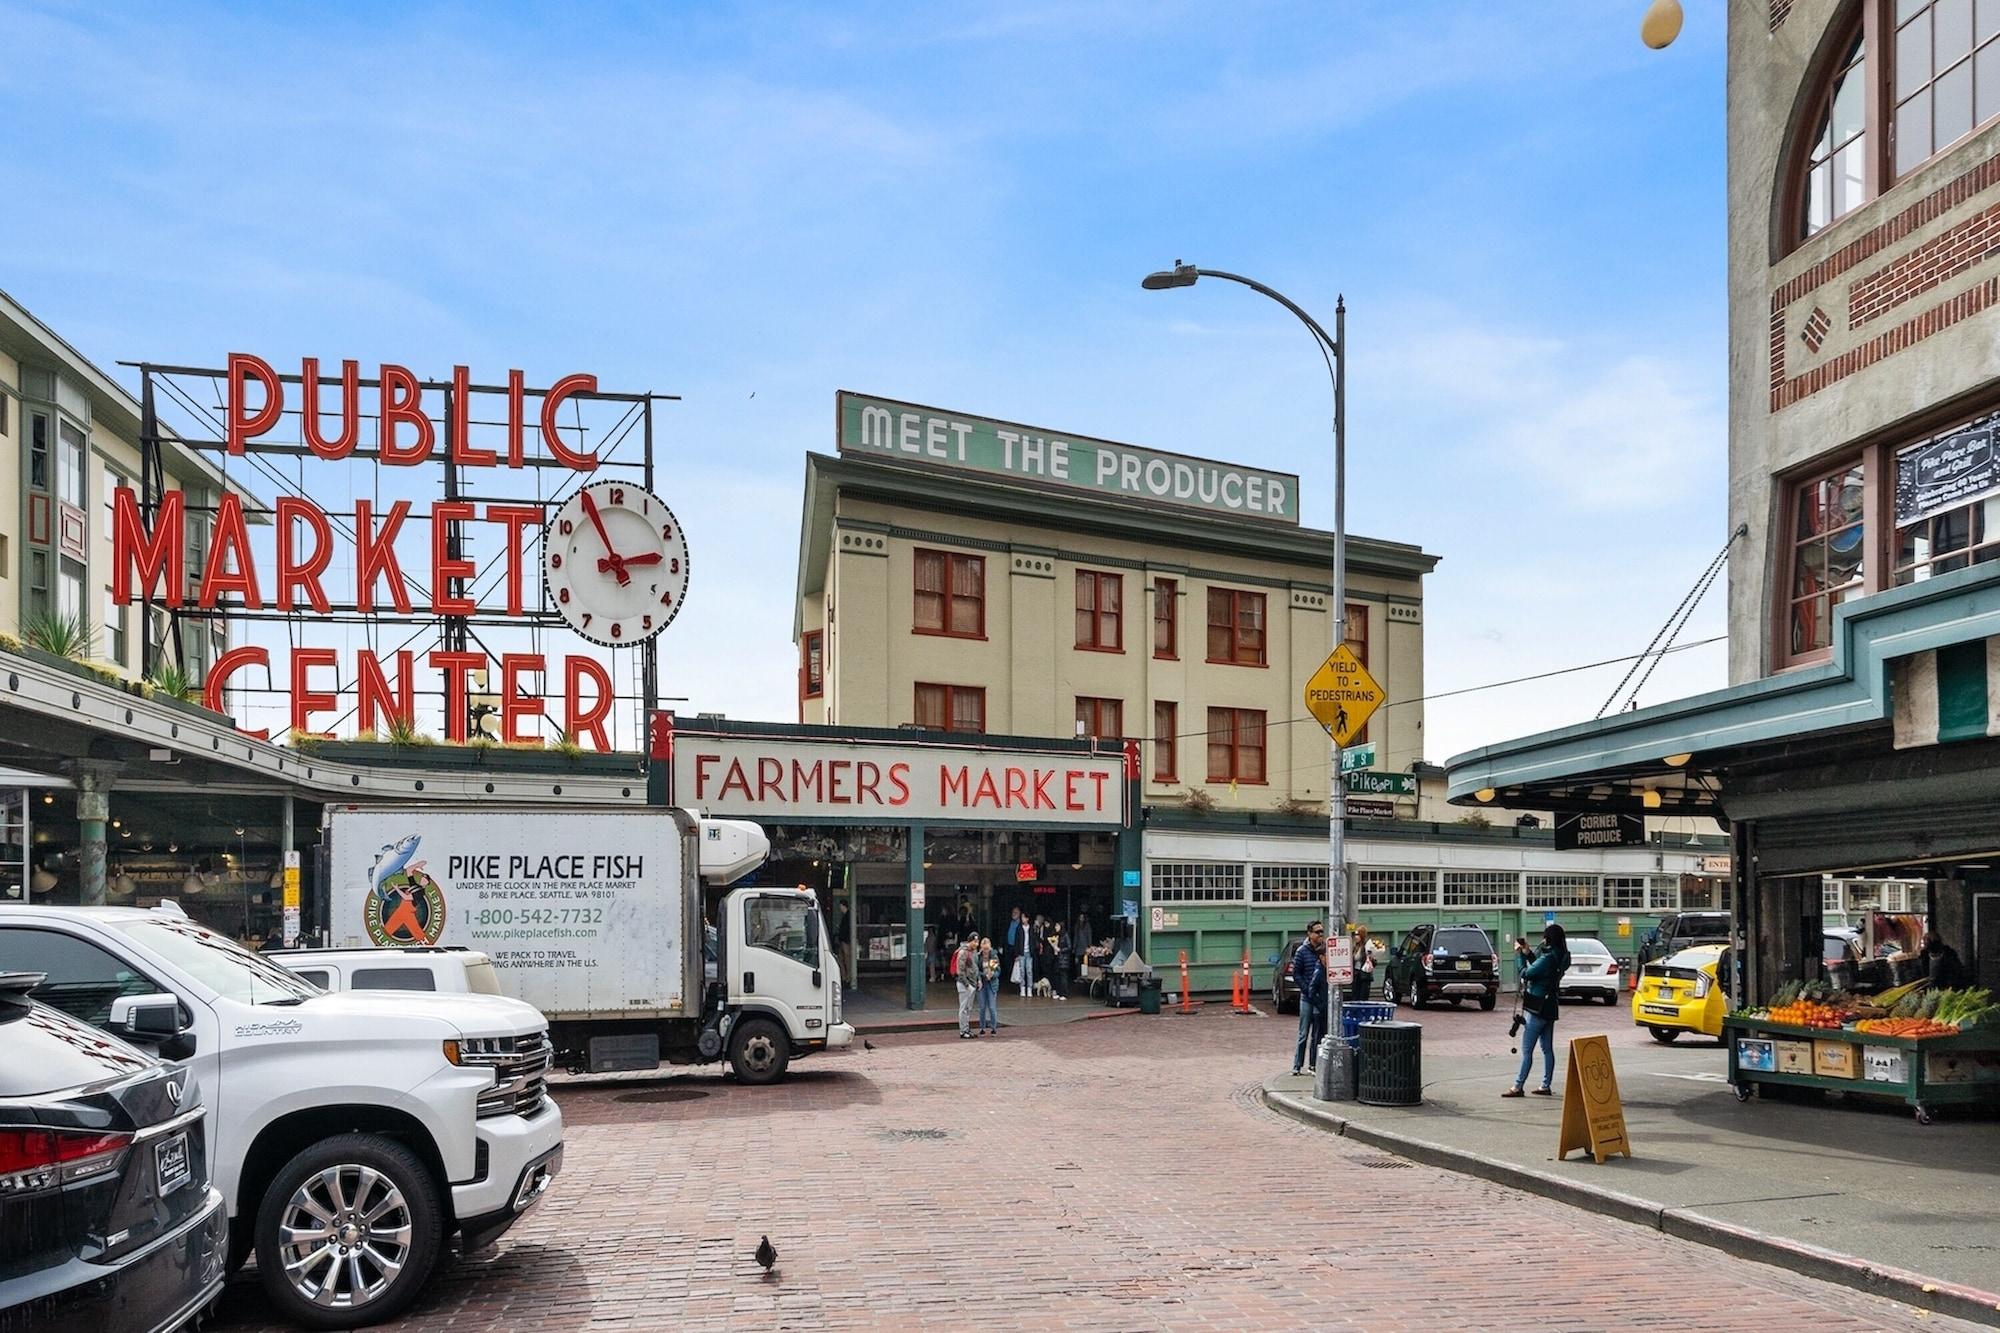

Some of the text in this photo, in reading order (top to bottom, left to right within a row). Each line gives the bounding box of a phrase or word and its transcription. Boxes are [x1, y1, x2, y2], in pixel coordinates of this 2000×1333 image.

[228, 352, 597, 472] PUBLIC
[861, 405, 1286, 514] MEET THE PRODUCER
[1921, 457, 1940, 471] Pike
[1940, 447, 1966, 464] Place
[609, 488, 624, 505] 12
[559, 519, 572, 536] 10
[663, 524, 672, 540] 2
[112, 487, 544, 616] MARKET
[552, 554, 562, 568] 9
[670, 558, 679, 574] 3
[560, 588, 570, 603] 8
[660, 591, 672, 606] 4
[582, 613, 592, 628] 7
[643, 615, 651, 630] 5
[611, 623, 621, 638] 6
[1329, 662, 1357, 673] YIELD
[1337, 676, 1349, 687] TO
[203, 646, 615, 753] CENTER
[1310, 690, 1374, 702] PEDESTRIANS
[696, 754, 1109, 811] FARMERS MARKET
[1351, 772, 1377, 790] Pike
[1580, 814, 1618, 829] CORNER
[1577, 829, 1622, 845] PRODUCE
[448, 856, 643, 879] PIKE PLACE FISH
[1709, 861, 1730, 870] ENTR
[456, 882, 484, 890] UNDER
[368, 898, 378, 927] PIKE
[428, 890, 442, 937] MARKET
[464, 909, 603, 925] 1-800-542-7732
[471, 928, 597, 940] www.pikeplacefish.com
[490, 960, 509, 969] PING
[512, 960, 554, 968] ANYWHERE
